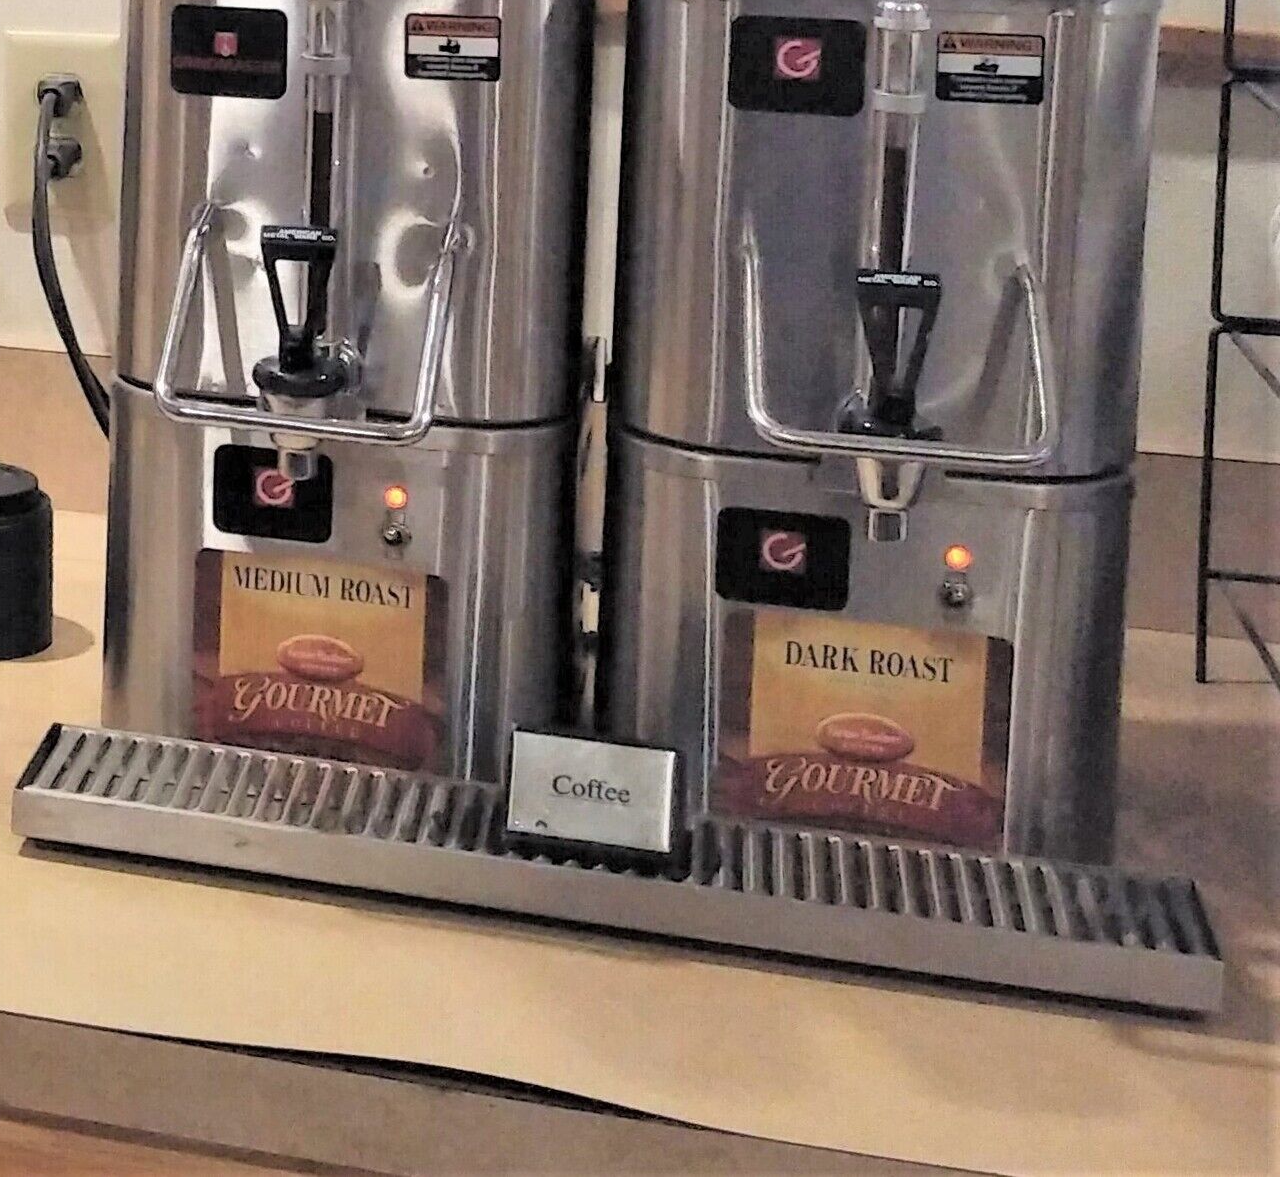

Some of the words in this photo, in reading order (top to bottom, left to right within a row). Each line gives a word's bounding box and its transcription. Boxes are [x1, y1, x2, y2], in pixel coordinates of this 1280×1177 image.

[232, 565, 330, 599] MEDIUM
[340, 577, 414, 609] ROAST
[785, 639, 860, 673] DARK
[869, 649, 954, 683] ROAST
[228, 676, 407, 728] GOURMET
[551, 774, 631, 804] Coffee
[759, 757, 967, 811] GOURMET
